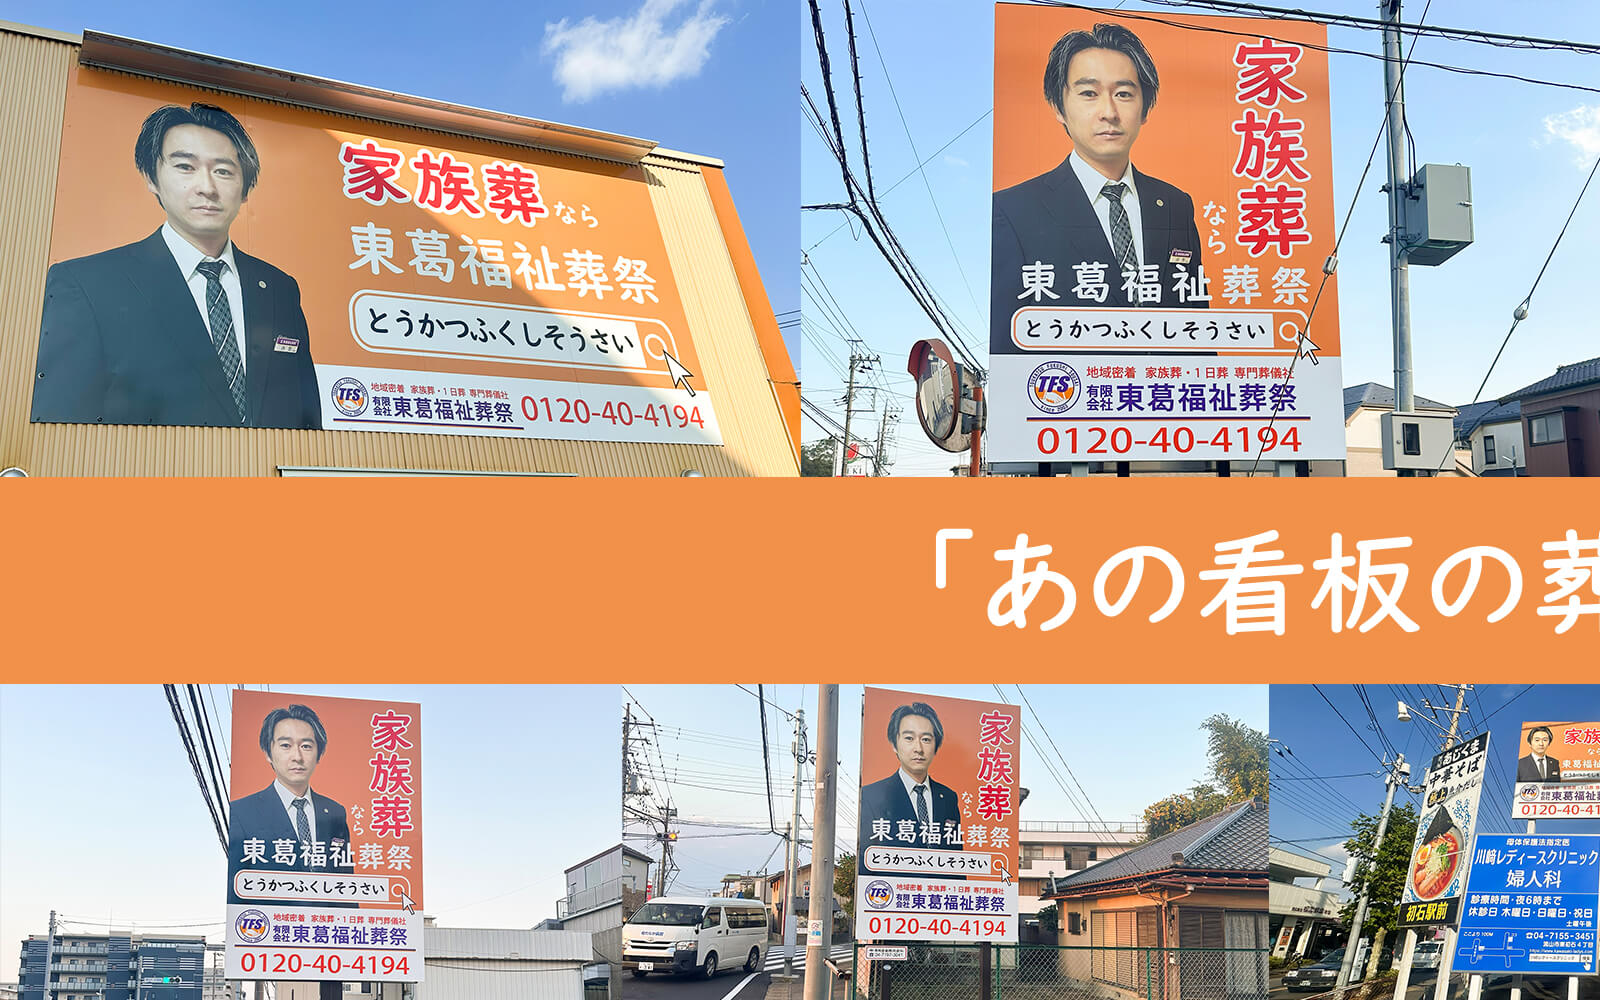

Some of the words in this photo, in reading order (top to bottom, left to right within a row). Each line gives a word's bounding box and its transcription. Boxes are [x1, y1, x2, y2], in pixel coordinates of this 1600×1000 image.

[1233, 38, 1312, 258] 家族葬
[340, 140, 547, 226] 家族葬
[554, 201, 598, 228] なら
[1203, 201, 1226, 256] なら
[348, 222, 659, 304] 東葛福祉葬祭
[1018, 261, 1310, 305] 東葛福祉葬祭
[367, 308, 633, 354] とうかつふくしそうさい
[1026, 317, 1267, 341] とうかつふくしそうさい
[1038, 376, 1070, 392] TFS
[1086, 366, 1136, 379] 地域密着
[1234, 366, 1294, 379] 専門葬儀社
[339, 388, 360, 400] TFS
[373, 396, 391, 406] 有限
[1086, 384, 1112, 397] 有限
[1116, 383, 1297, 412] 東葛福祉葬祭
[373, 406, 392, 416] 会社
[393, 396, 514, 423] 東葛福祉葬祭
[521, 395, 705, 430] 0120-40-4194
[1086, 398, 1113, 411] 会社
[1037, 427, 1302, 454] 0120-40-4194
[371, 710, 413, 838] 家族葬
[978, 711, 1013, 821] 家族葬
[1429, 754, 1483, 789] 中華そば
[961, 791, 973, 818] なら
[351, 806, 365, 836] なら
[869, 818, 1011, 849] 東葛福祉葬祭
[240, 837, 413, 871] 東葛福祉葬祭
[871, 852, 988, 870] とうかつふくしそうさい
[243, 878, 385, 896] とうかつふくしそうさい
[1505, 869, 1562, 889] 婦人科
[870, 887, 889, 897] TFS
[911, 893, 1005, 912] 東葛福祉葬祭
[1406, 901, 1448, 922] 初石駅前
[1468, 907, 1498, 917] 休診日
[242, 919, 263, 930] TFS
[292, 925, 407, 946] 東葛福祉葬祭
[869, 917, 1006, 936] 0120-40-4194
[1533, 931, 1594, 940] 04-7155-3451
[240, 952, 410, 975] 0120-40-4194
